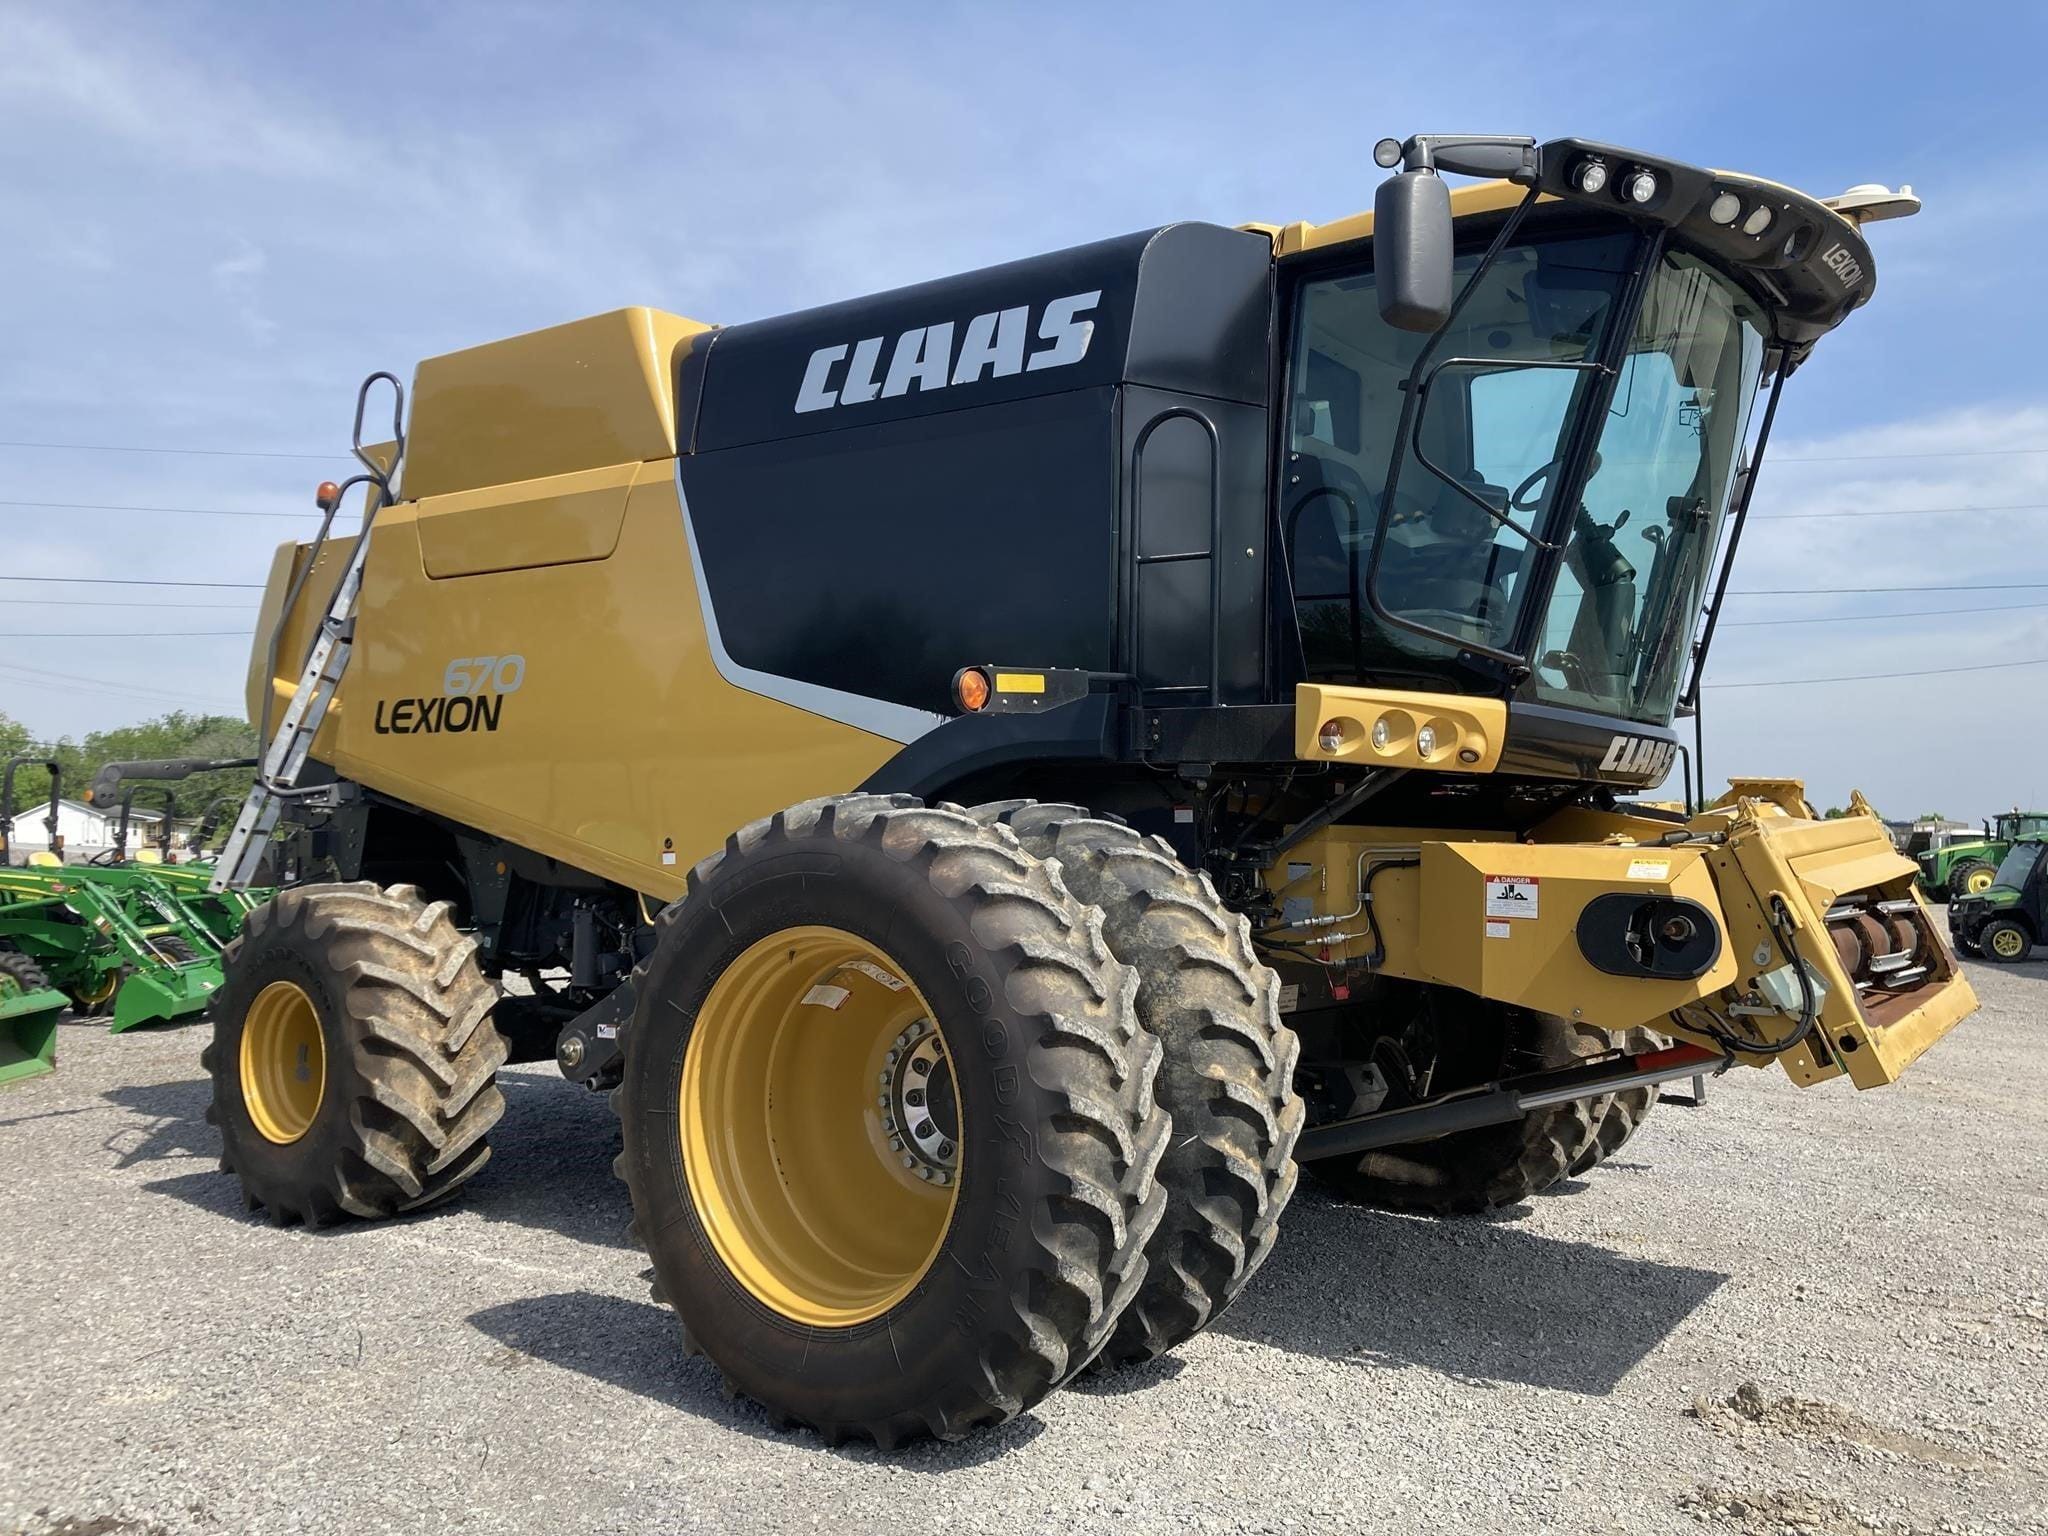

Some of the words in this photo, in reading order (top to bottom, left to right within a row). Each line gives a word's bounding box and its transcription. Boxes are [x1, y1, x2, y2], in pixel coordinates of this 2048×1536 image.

[1822, 243, 1864, 289] LEXION
[794, 289, 1102, 414] CLAAS
[443, 654, 526, 695] 670
[374, 694, 503, 734] LEXION
[1599, 735, 1676, 777] CLAAS
